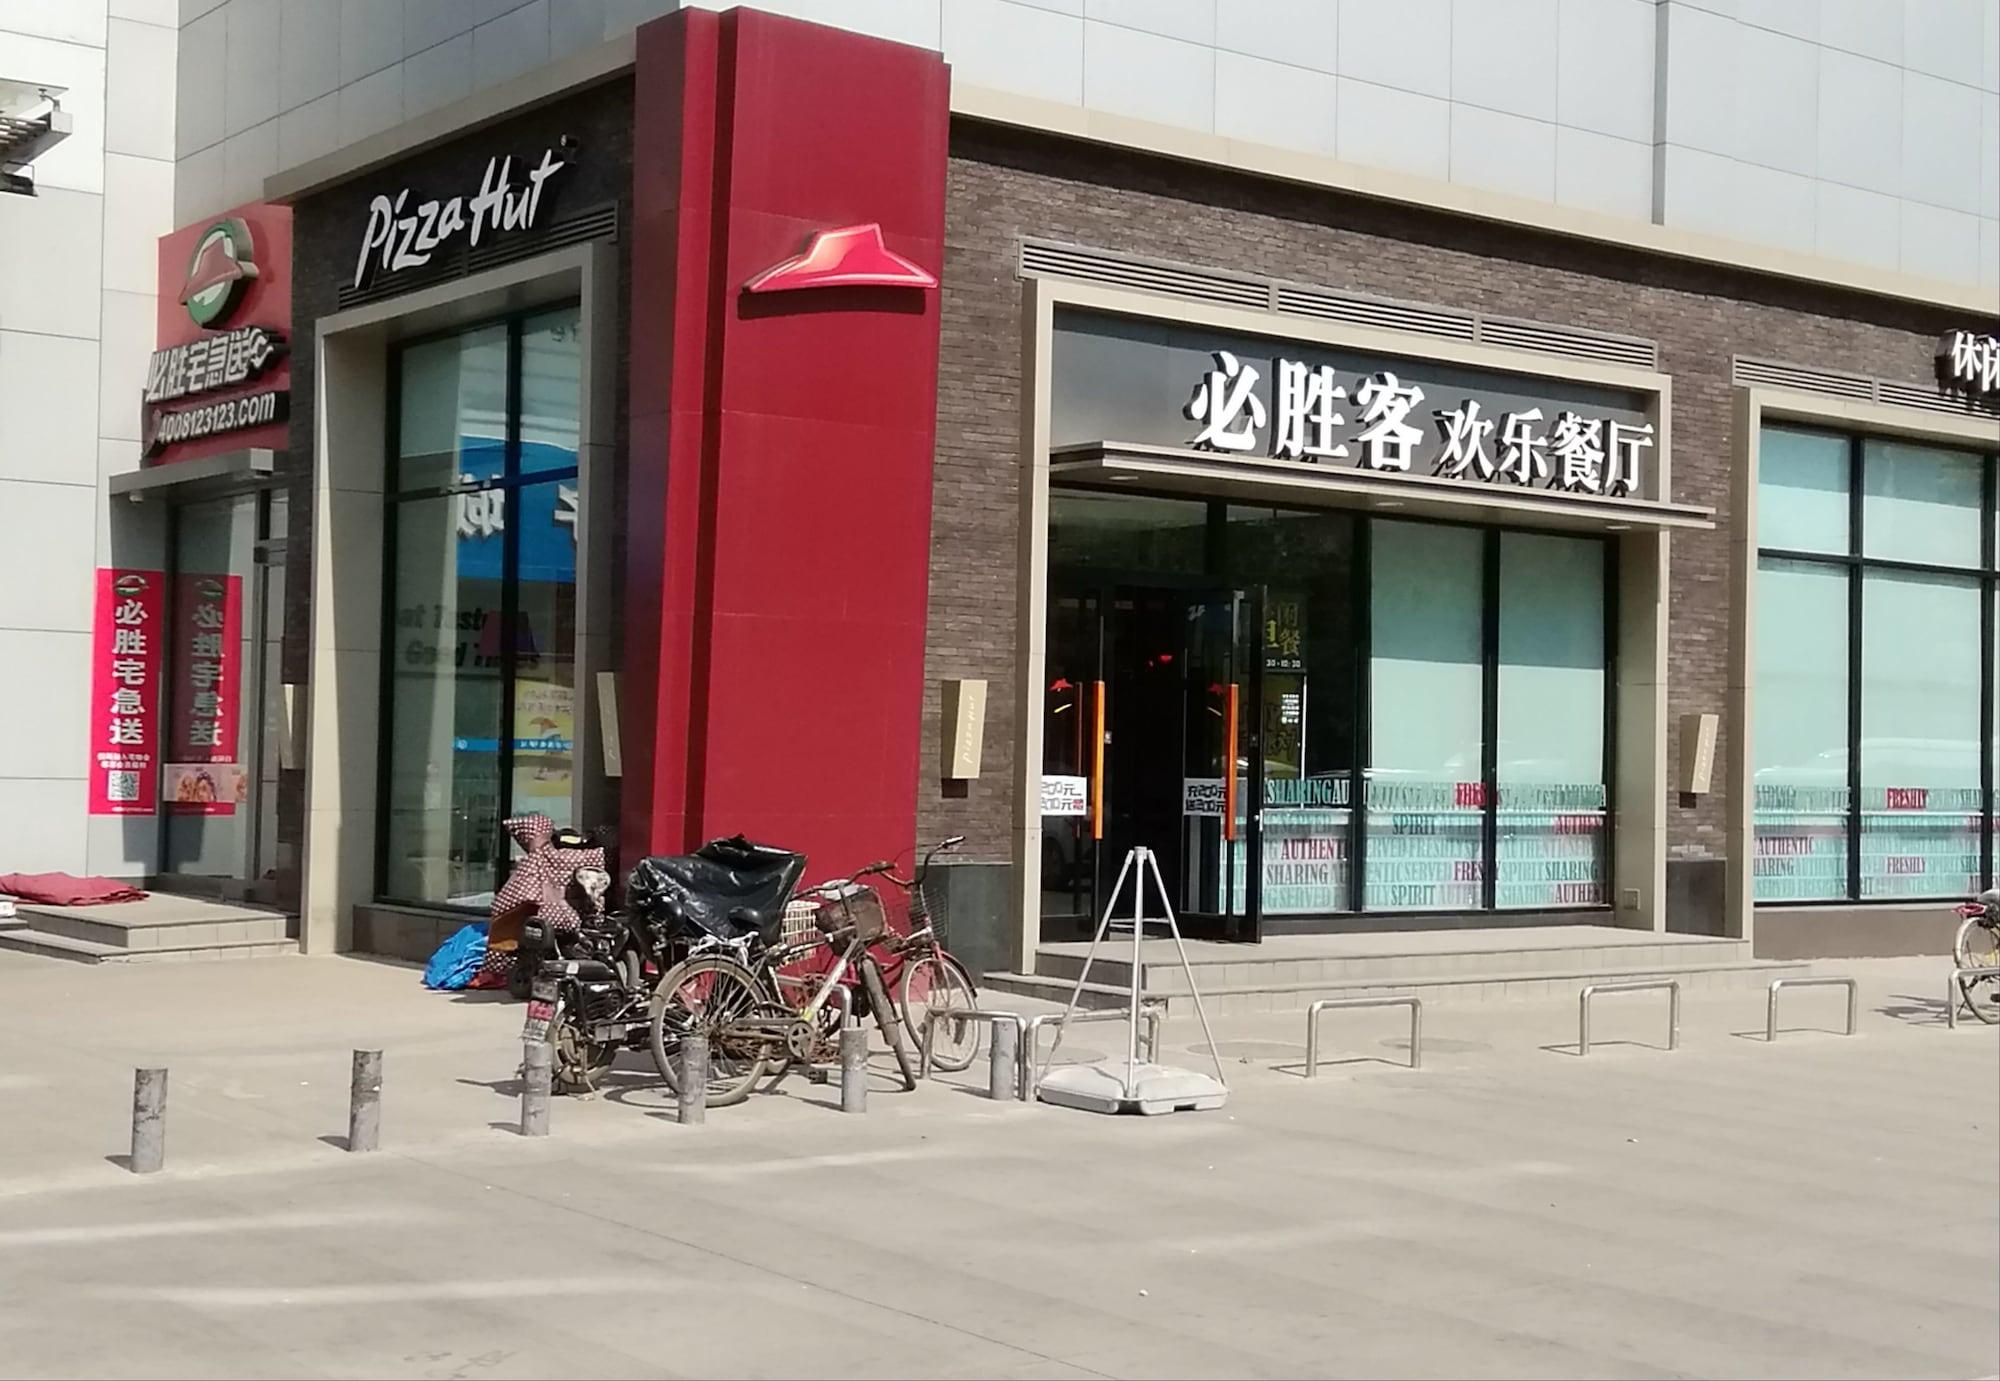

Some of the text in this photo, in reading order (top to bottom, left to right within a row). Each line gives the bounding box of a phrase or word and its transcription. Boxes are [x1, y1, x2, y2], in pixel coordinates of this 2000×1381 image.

[354, 149, 565, 288] Pizza Hut
[157, 392, 276, 444] 4008123123.com
[1188, 350, 1654, 493] 必胜客 欢乐餐厅
[108, 599, 149, 745] 必胜宅急送
[1392, 812, 1436, 836] SPIRIT
[1266, 863, 1329, 886] SHARING
[1390, 884, 1436, 906] SPIRIT
